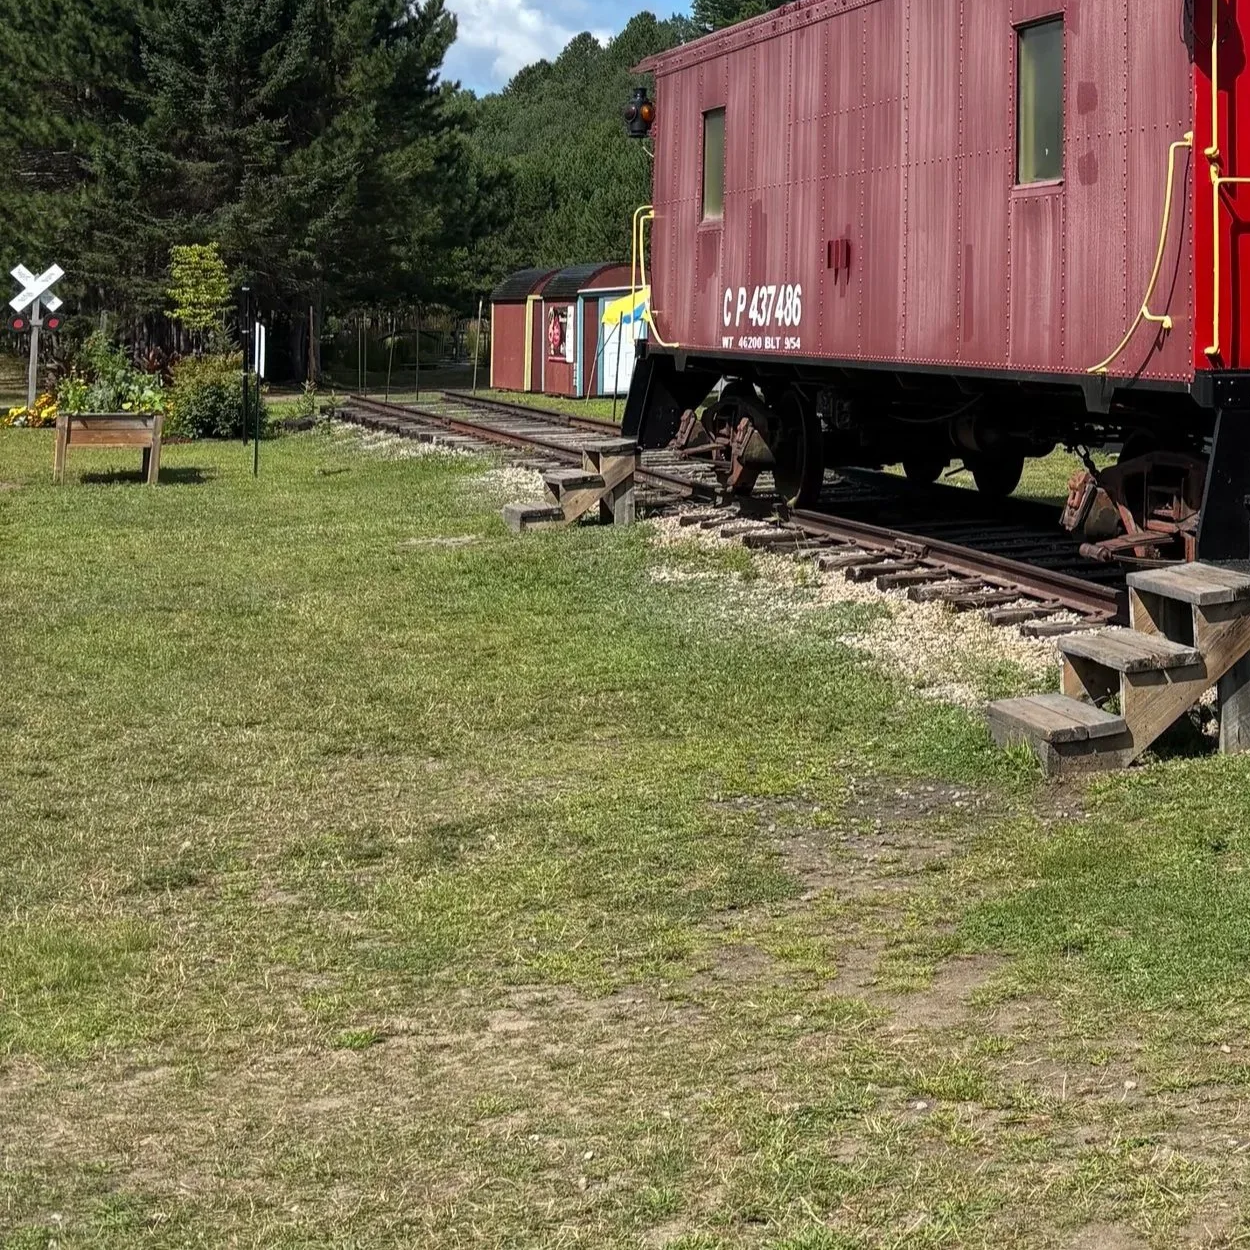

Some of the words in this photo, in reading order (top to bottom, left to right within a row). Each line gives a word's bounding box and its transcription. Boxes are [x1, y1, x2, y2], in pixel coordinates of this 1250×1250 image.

[748, 283, 802, 327] 437486
[722, 336, 734, 349] WT
[738, 336, 762, 349] 46200
[764, 336, 782, 350] BLT
